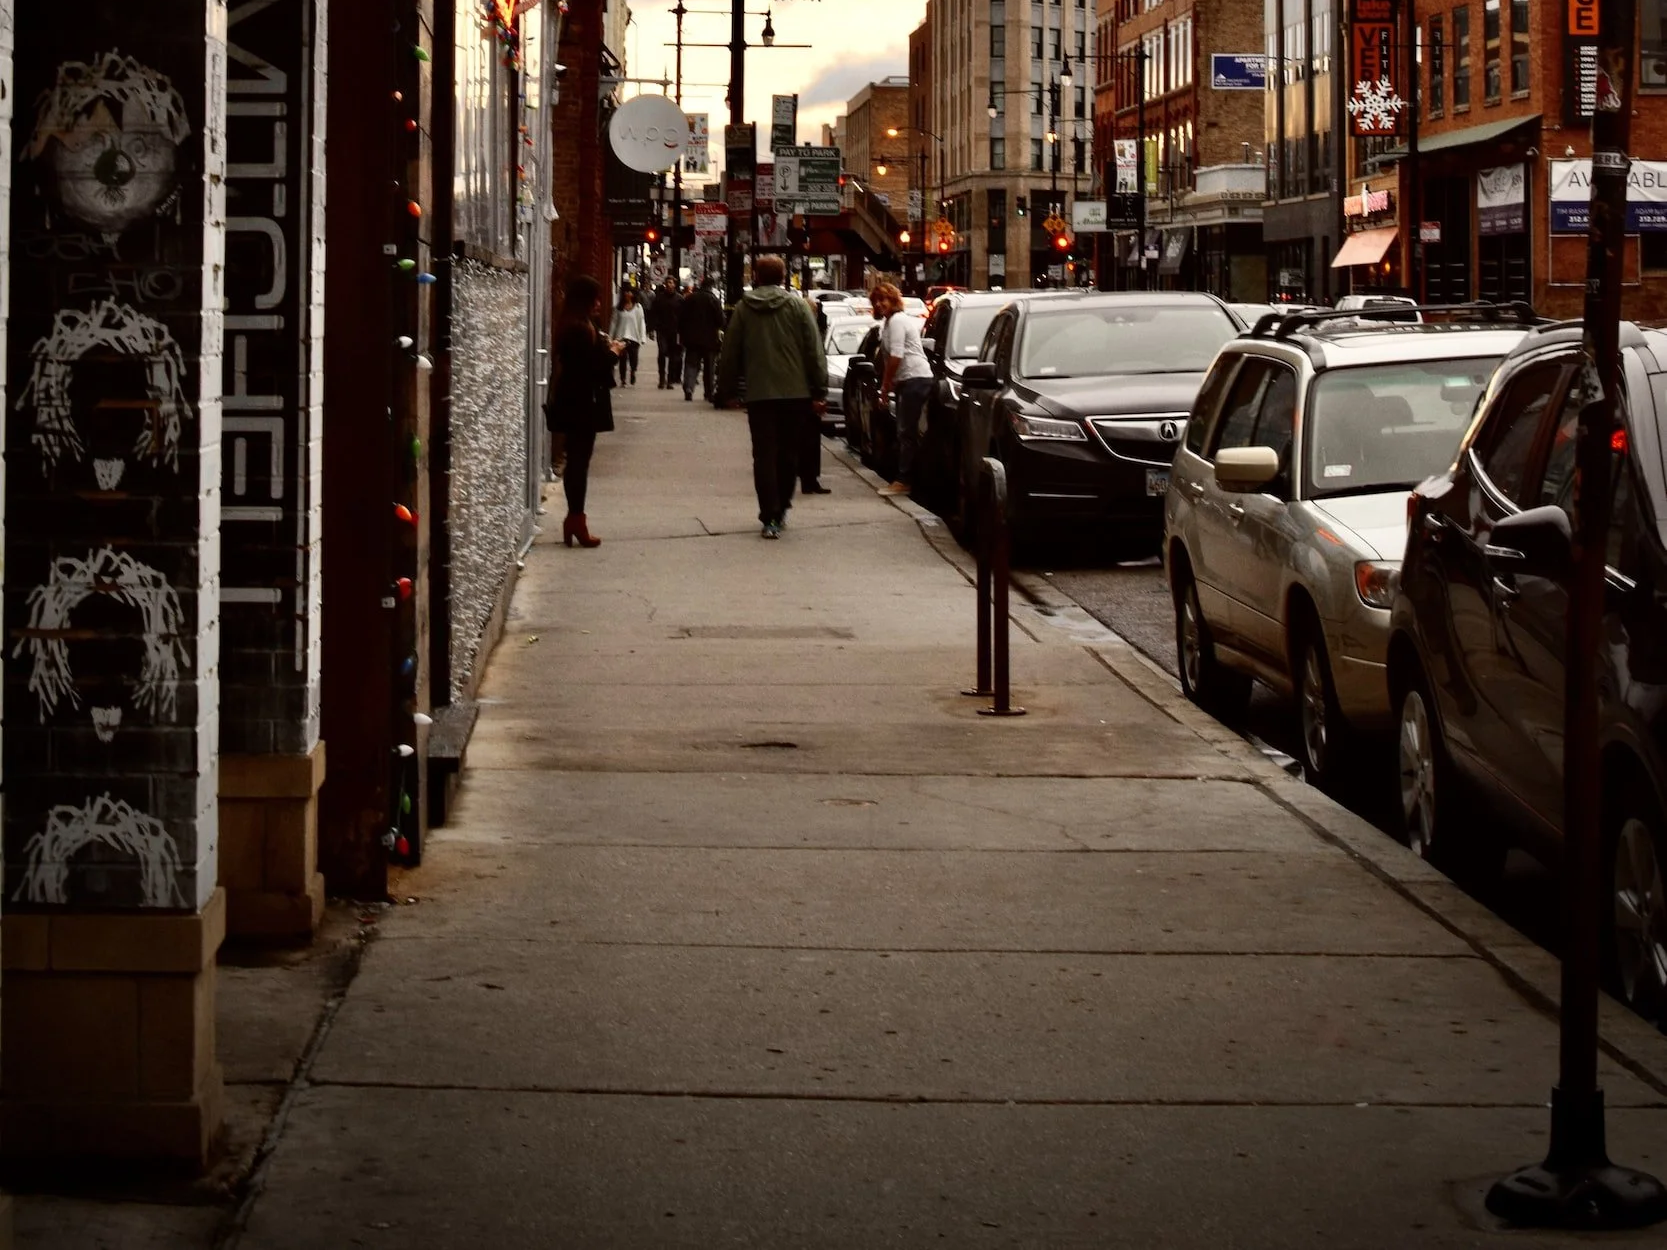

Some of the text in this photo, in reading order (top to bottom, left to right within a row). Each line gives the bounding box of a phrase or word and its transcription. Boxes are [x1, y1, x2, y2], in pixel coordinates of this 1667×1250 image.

[778, 147, 837, 157] PAY TO PARK
